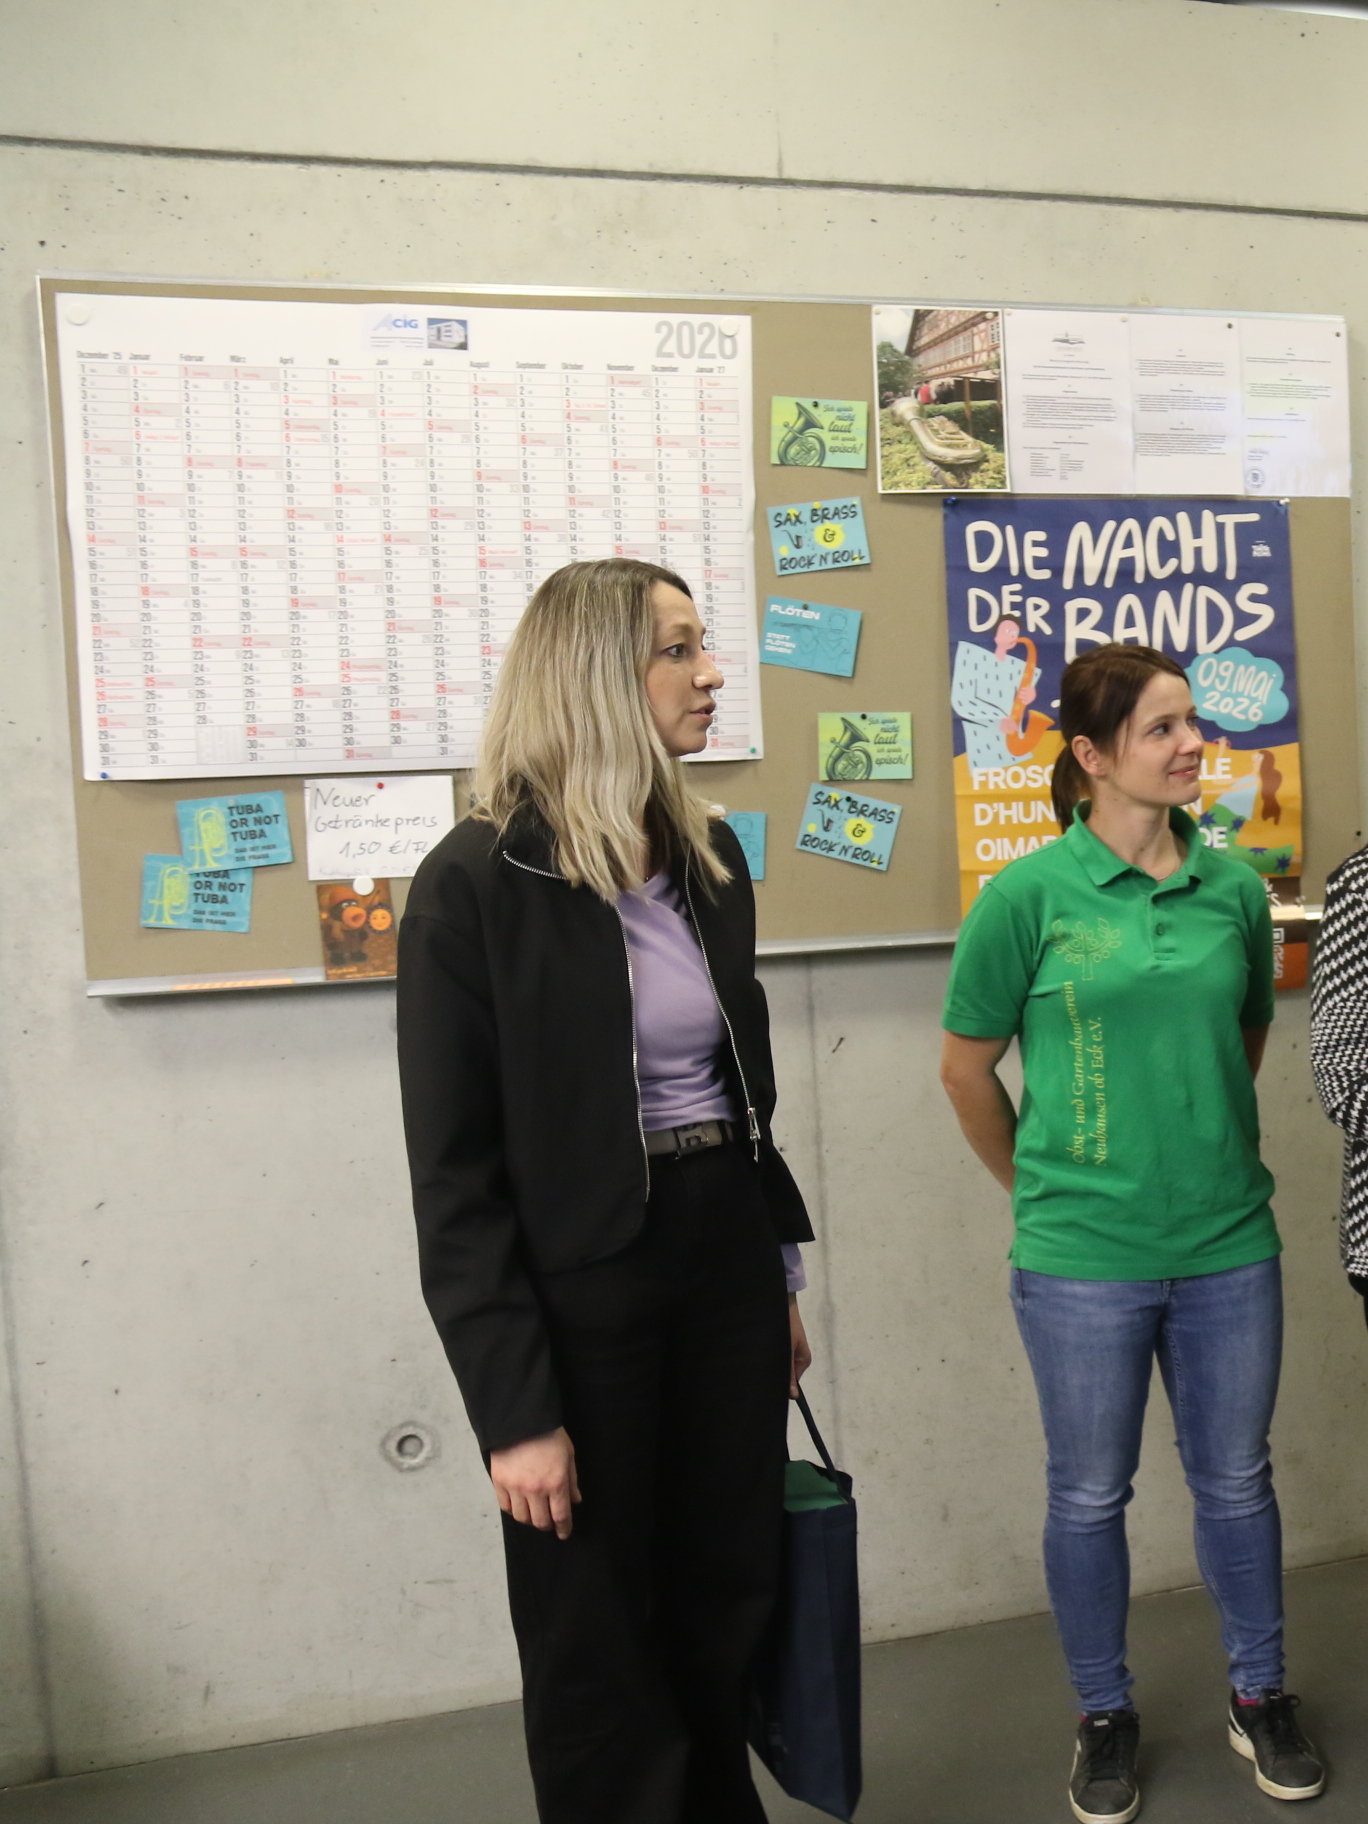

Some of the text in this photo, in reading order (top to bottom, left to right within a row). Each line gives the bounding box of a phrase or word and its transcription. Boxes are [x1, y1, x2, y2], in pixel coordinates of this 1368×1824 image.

[655, 320, 738, 360] 2026
[810, 504, 858, 524] BRASS
[823, 528, 836, 543] &
[965, 509, 1261, 590] DIE NACHT
[770, 604, 820, 621] FLÖTEN
[967, 582, 1275, 665] DER BANDS
[1202, 691, 1263, 722] 2026
[314, 787, 376, 810] Neuer
[227, 803, 263, 817] TUBA
[847, 801, 896, 824] BRASS
[229, 814, 281, 829] OR NOT
[852, 823, 866, 838] &
[231, 829, 267, 842] TUBA
[339, 840, 382, 859] 1,50
[193, 880, 246, 893] OR NOT
[193, 892, 229, 905] TUBA
[1061, 981, 1086, 1095] Gartenbauverein
[1086, 1044, 1105, 1068] Eck
[1087, 1072, 1105, 1088] ob
[1088, 1092, 1108, 1166] Neuhausen
[1066, 1128, 1086, 1164] Obst-
